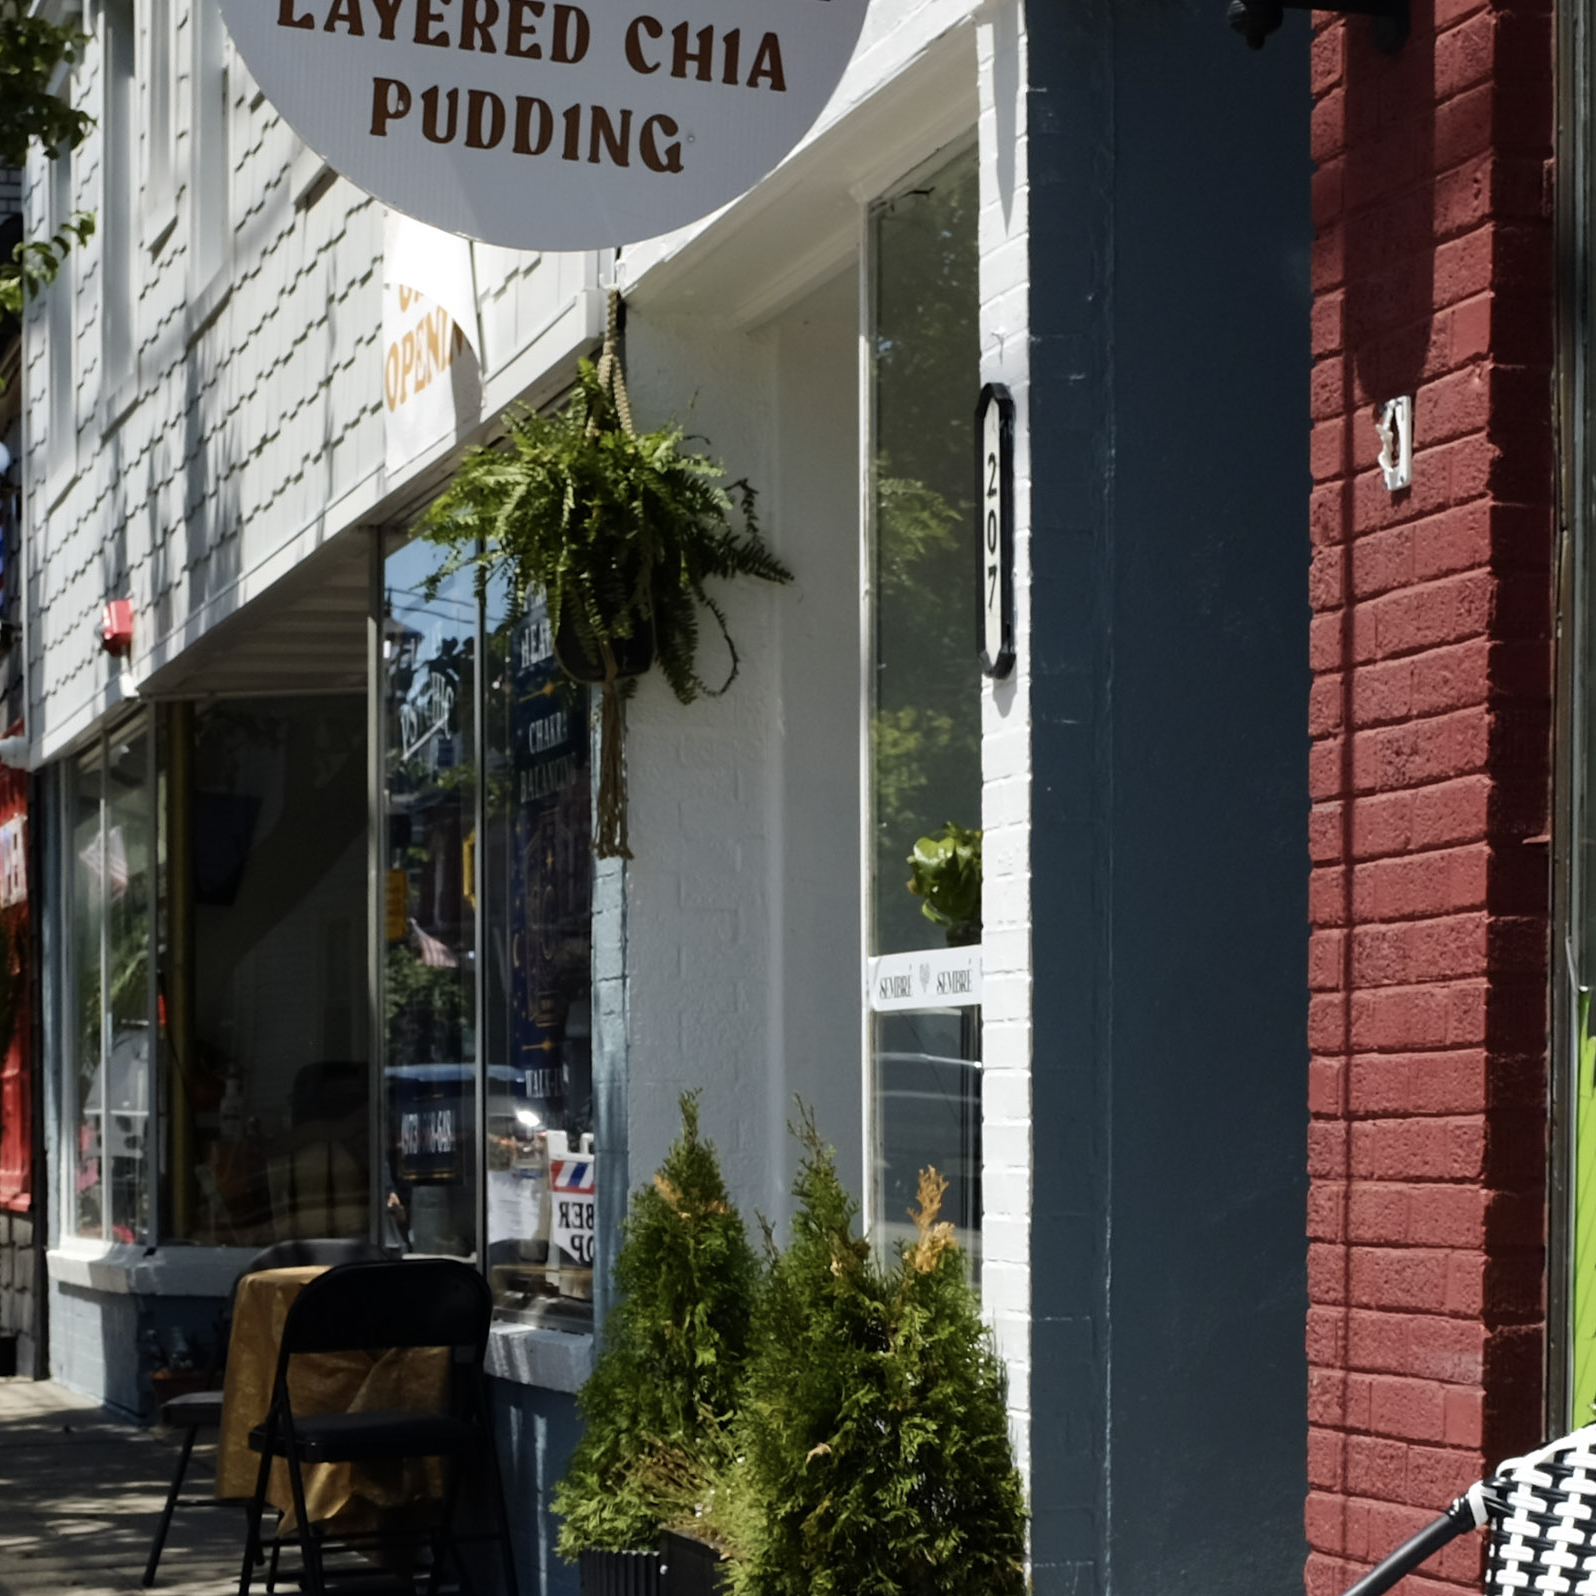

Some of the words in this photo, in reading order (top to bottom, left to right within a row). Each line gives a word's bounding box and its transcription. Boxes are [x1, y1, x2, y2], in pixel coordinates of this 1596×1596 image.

[624, 14, 786, 92] CHIA
[369, 76, 684, 173] PUDDING
[986, 452, 998, 610] 207
